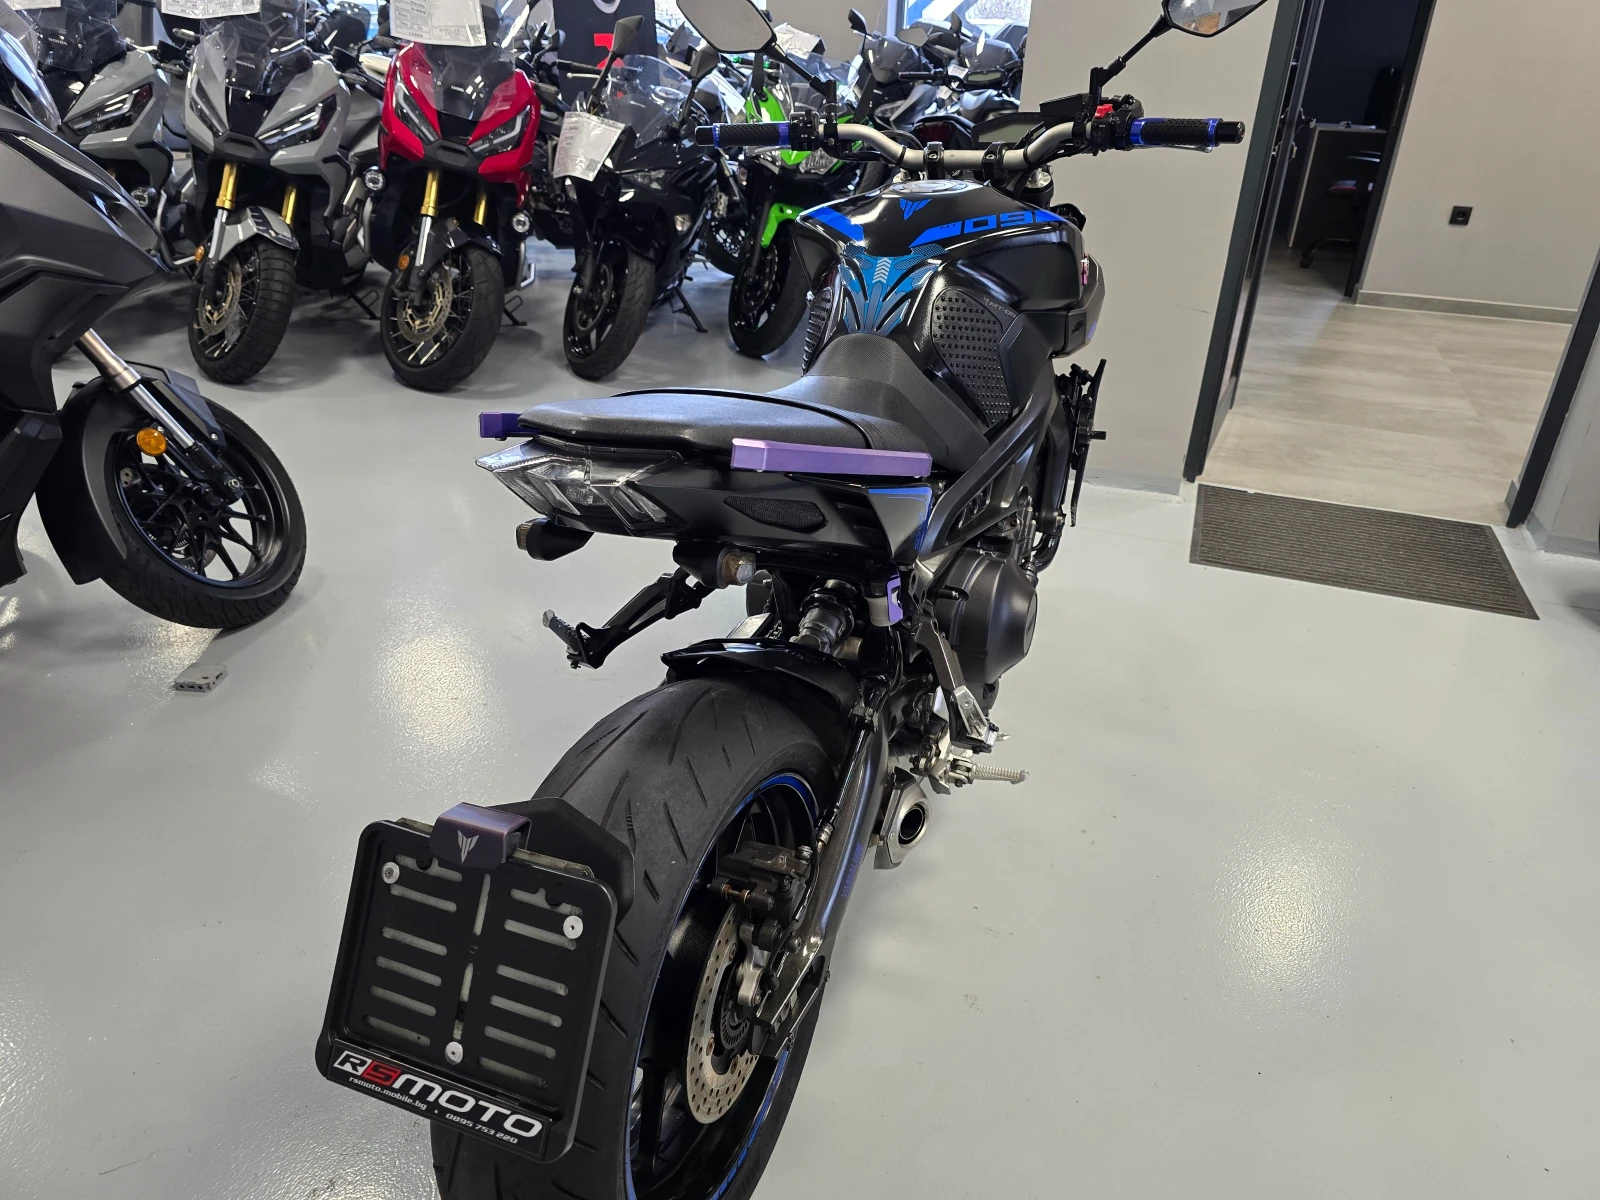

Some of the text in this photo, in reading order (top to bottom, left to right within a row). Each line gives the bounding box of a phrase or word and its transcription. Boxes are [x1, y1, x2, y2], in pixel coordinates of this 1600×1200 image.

[964, 210, 1033, 234] 09
[333, 1050, 543, 1138] RSMOTO
[348, 1076, 519, 1144] rsmoto.mobile.bg 0895 753 220
